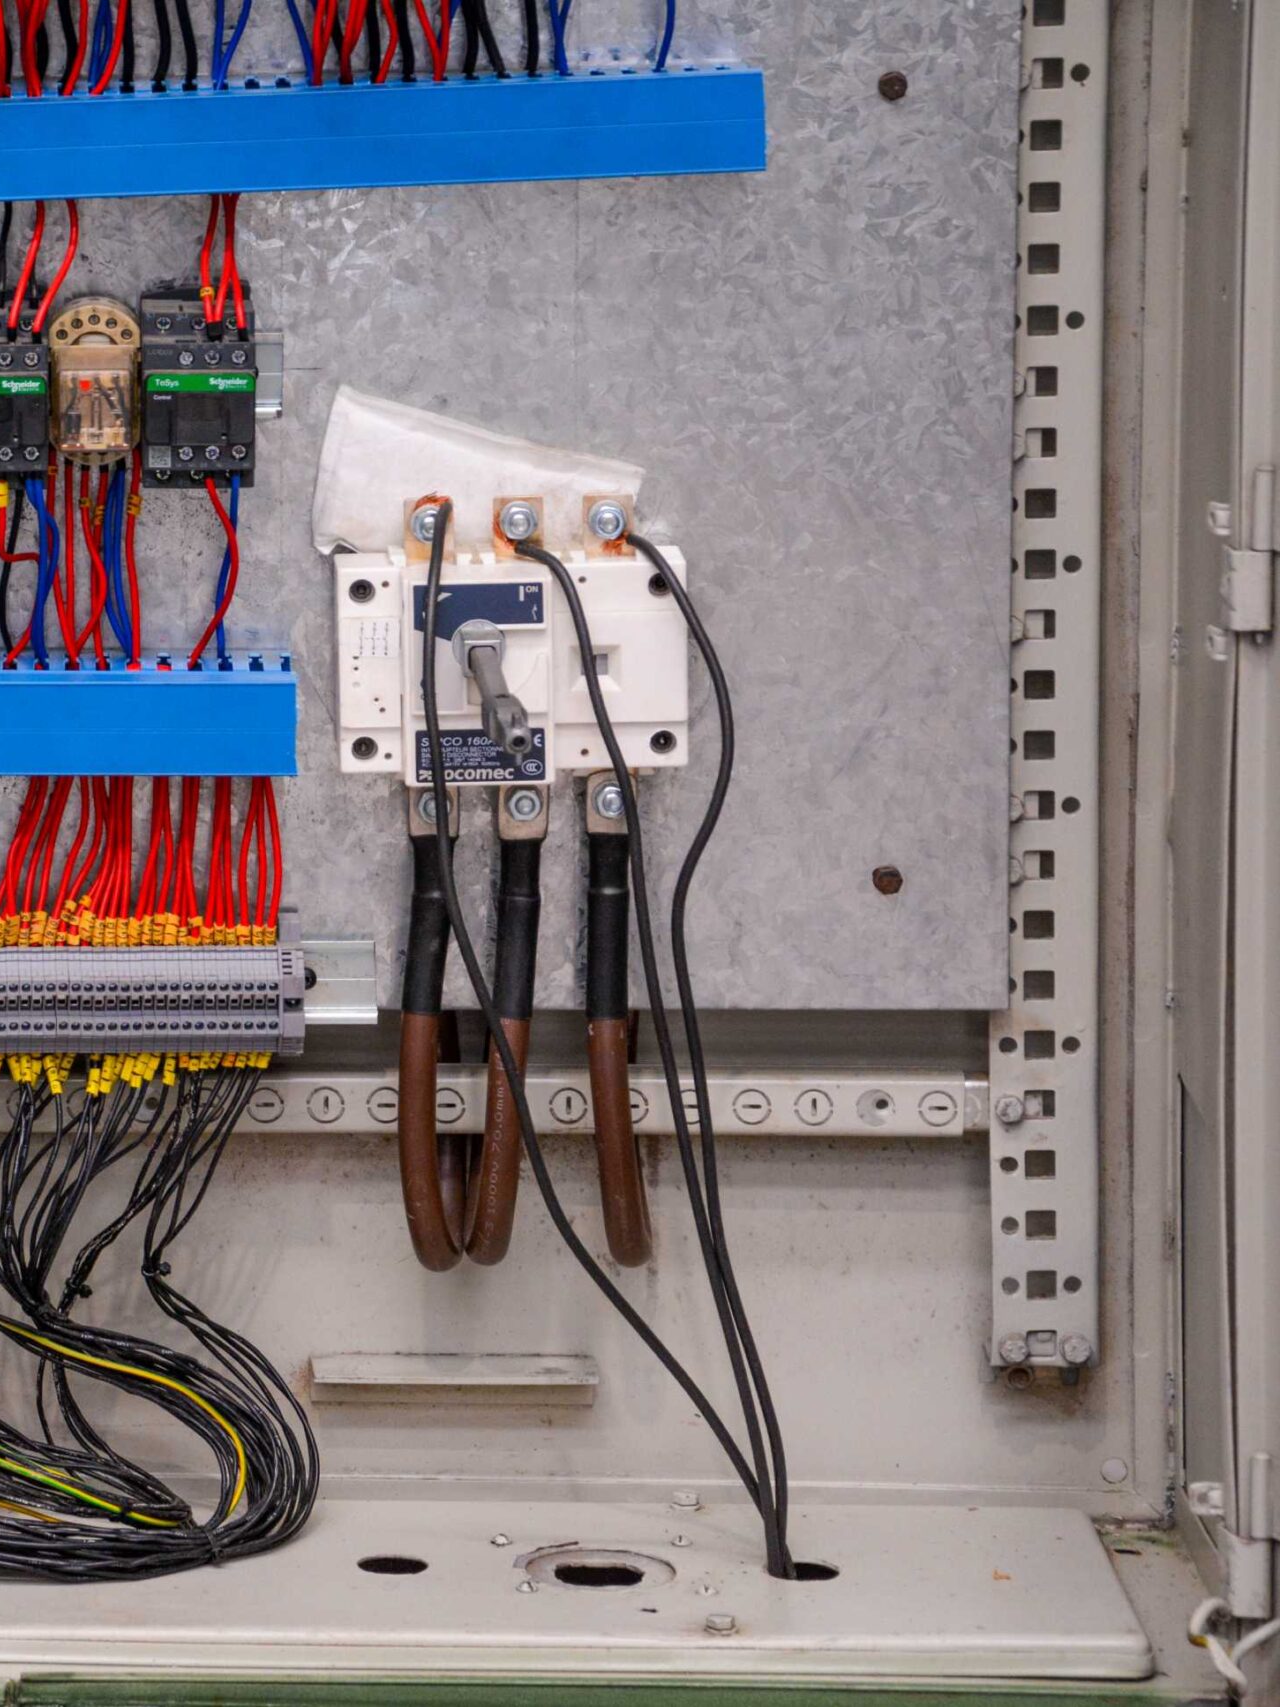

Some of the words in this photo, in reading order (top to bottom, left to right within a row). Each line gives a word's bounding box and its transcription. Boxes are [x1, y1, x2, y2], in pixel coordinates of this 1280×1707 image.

[2, 380, 41, 393] Schneider
[155, 378, 180, 388] TeSys
[209, 377, 248, 390] Schneider
[525, 585, 539, 594] ON
[421, 736, 463, 747] SCO
[442, 767, 515, 781] ocomec
